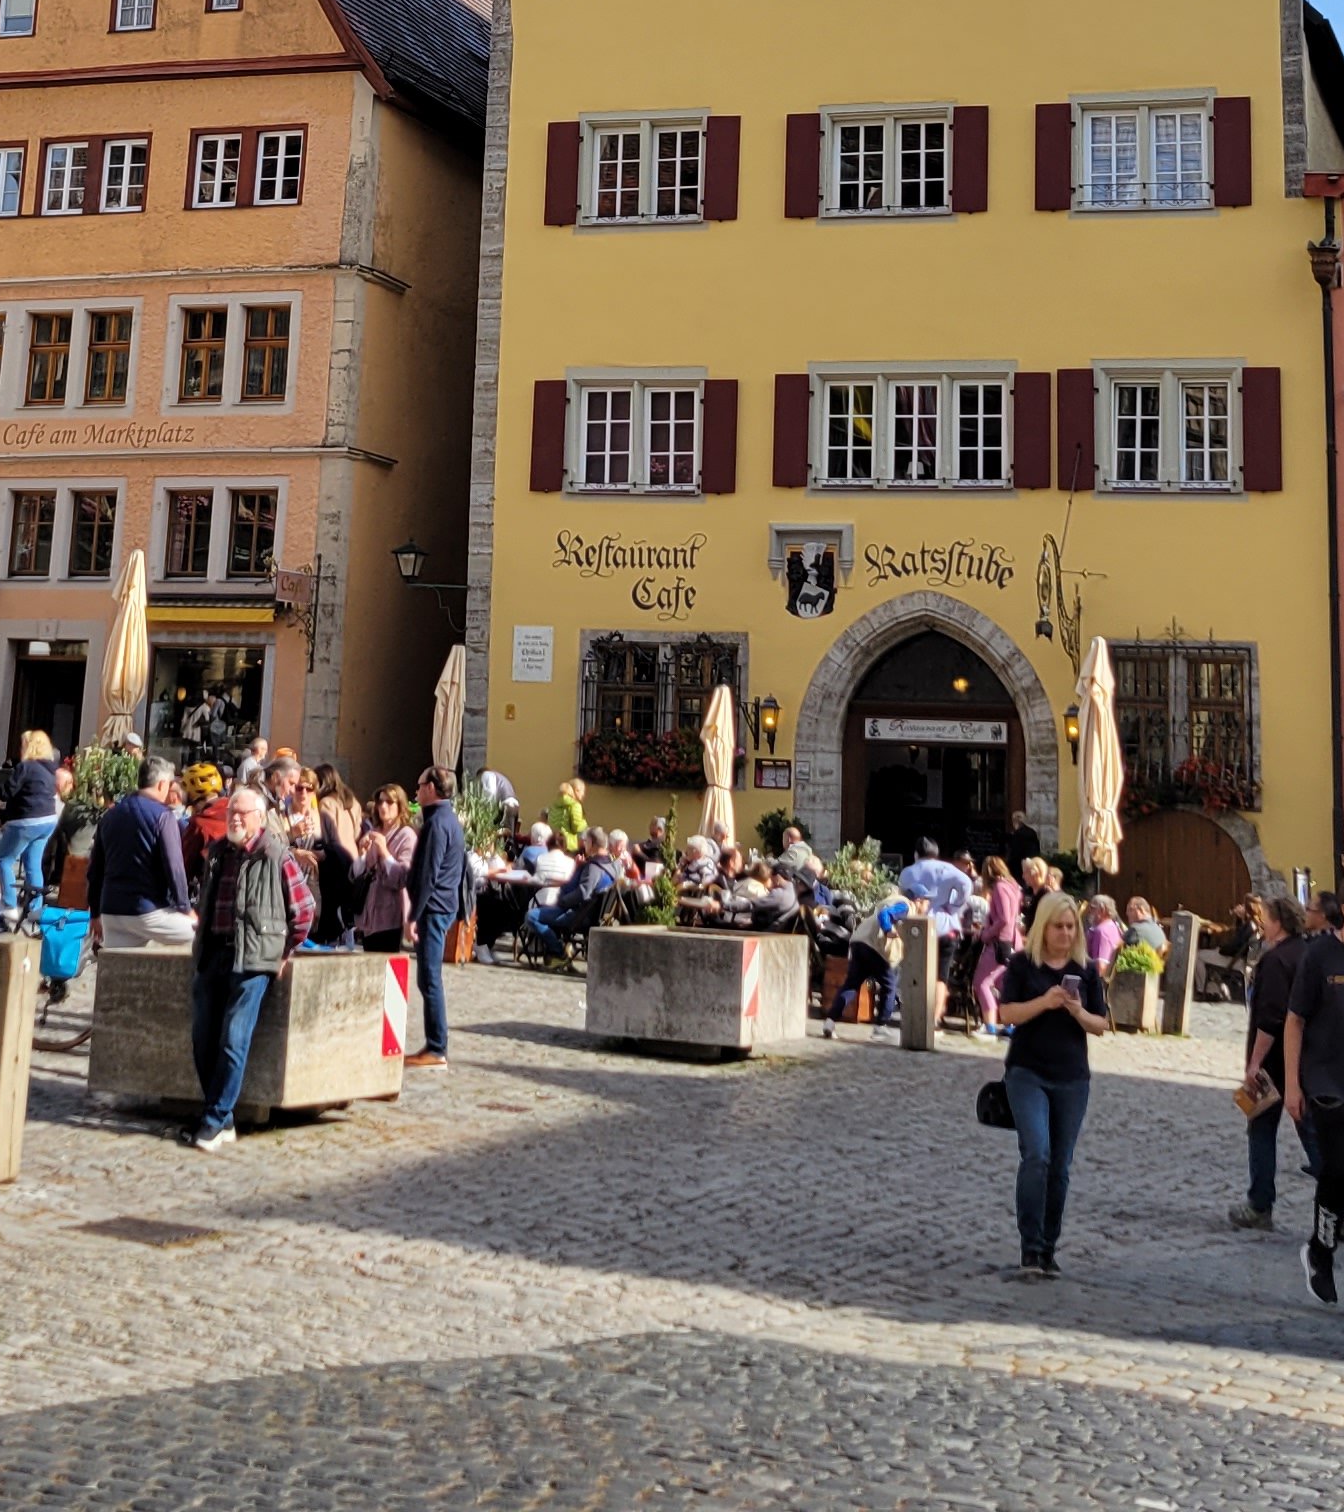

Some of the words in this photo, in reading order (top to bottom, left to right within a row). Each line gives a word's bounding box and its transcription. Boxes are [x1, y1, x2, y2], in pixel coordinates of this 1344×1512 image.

[2, 422, 46, 450] Café
[49, 428, 77, 445] am
[82, 421, 195, 448] Marktplatz
[552, 529, 708, 578] Restaurant
[863, 537, 1016, 590] Ratsstube
[631, 575, 697, 622] Cafe
